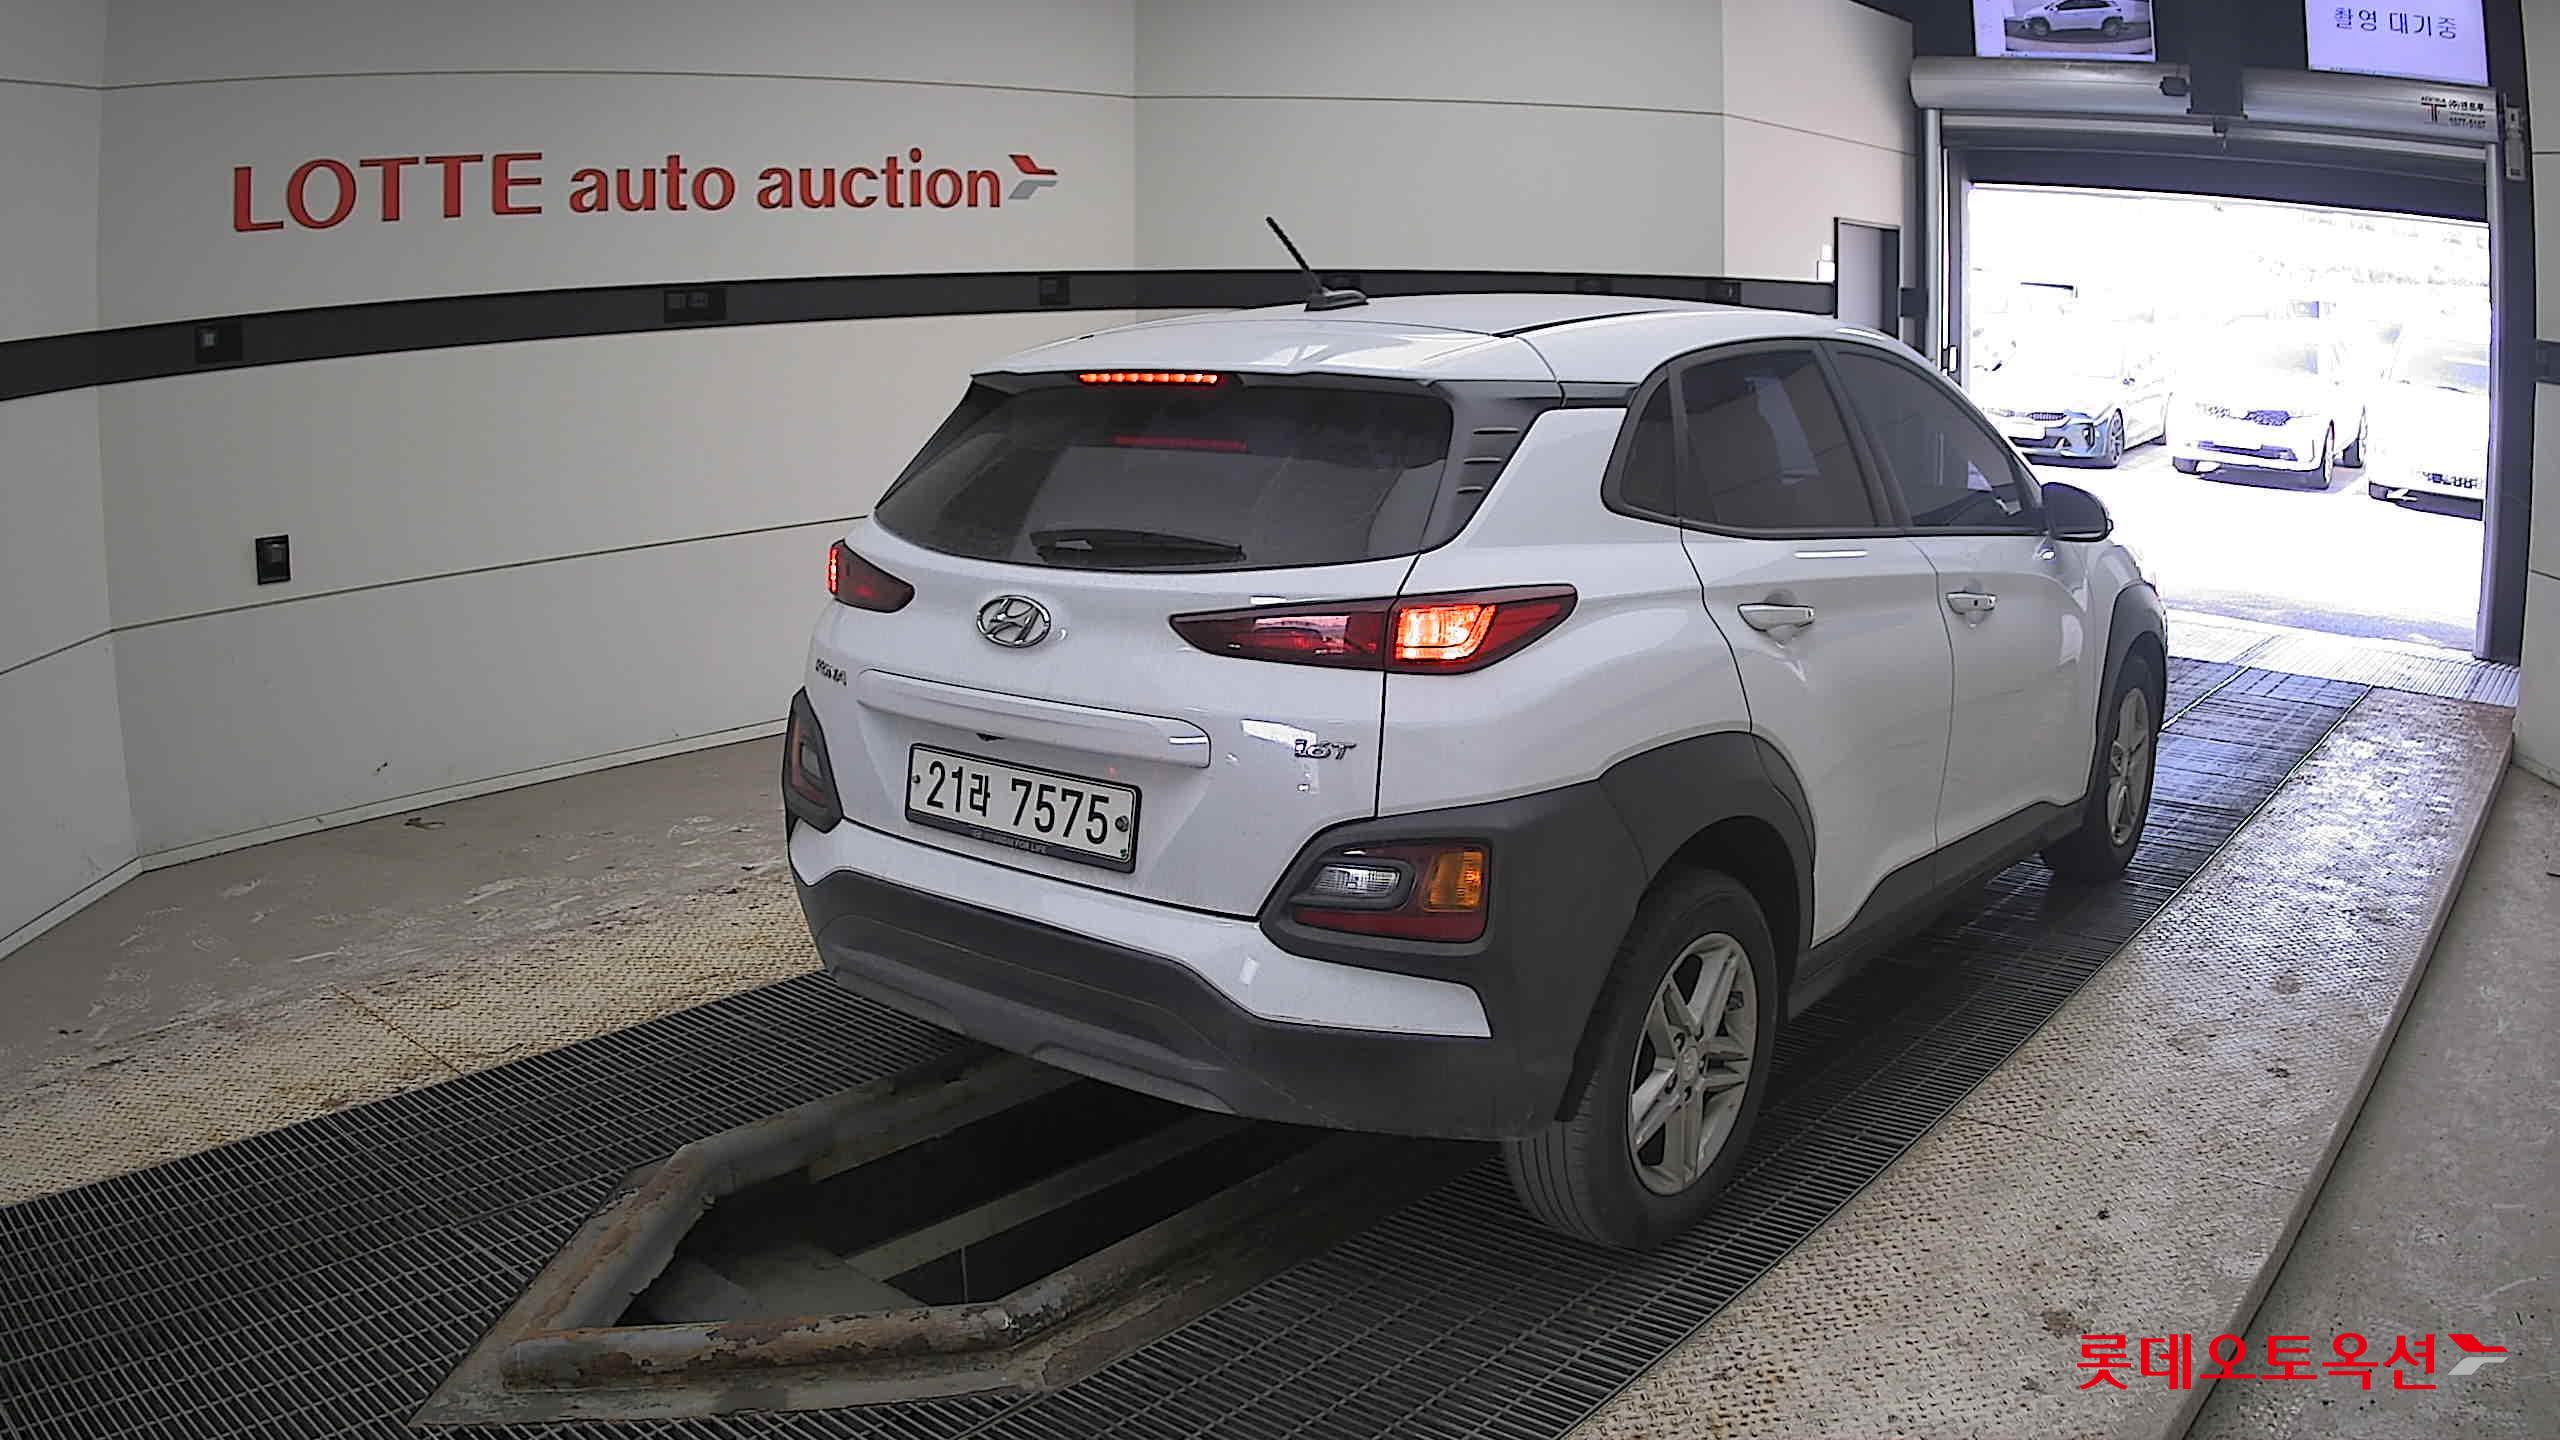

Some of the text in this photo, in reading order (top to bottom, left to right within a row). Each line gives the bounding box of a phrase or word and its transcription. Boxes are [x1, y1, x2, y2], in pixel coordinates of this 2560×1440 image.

[2389, 11, 2457, 40] 대기중
[233, 147, 1003, 233] LOTTE auto auction
[926, 760, 1110, 845] 21라 7575
